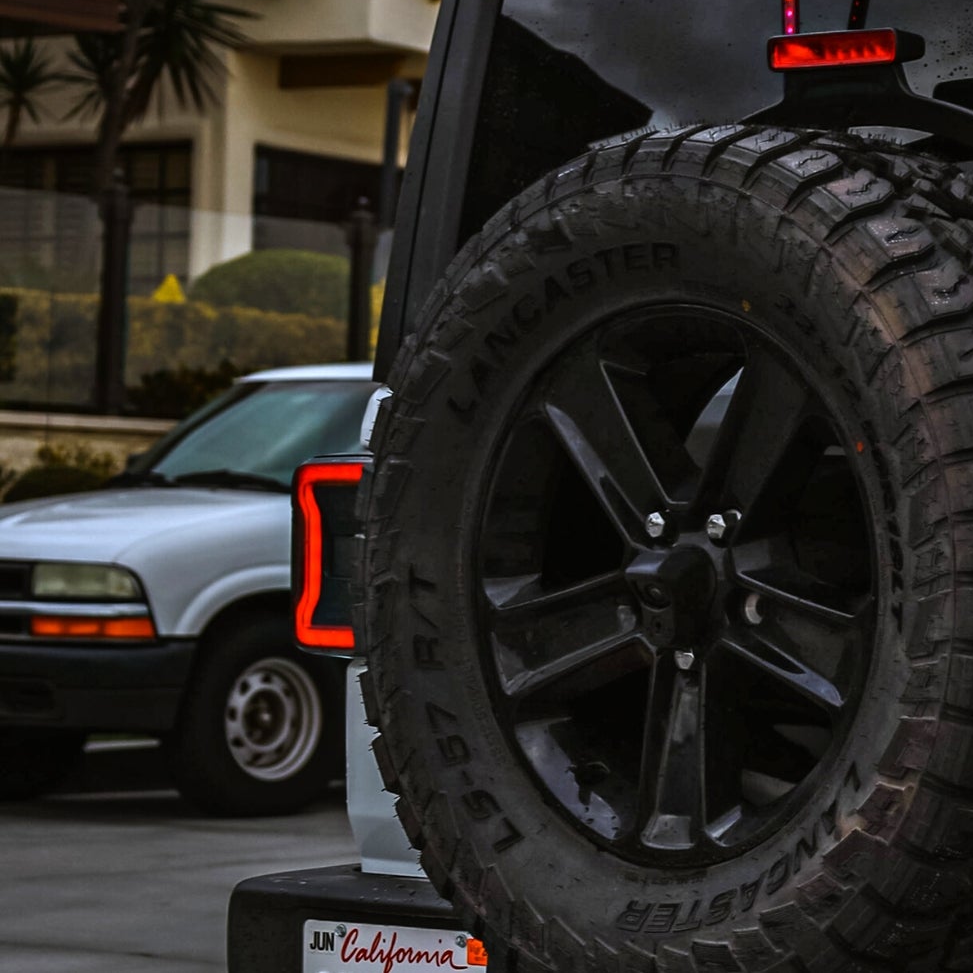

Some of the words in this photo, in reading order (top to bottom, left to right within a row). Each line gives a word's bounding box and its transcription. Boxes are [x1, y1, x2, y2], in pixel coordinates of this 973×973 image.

[446, 241, 682, 418] LANCASTER
[408, 562, 447, 671] R/T
[615, 760, 863, 934] LANCASTER
[310, 930, 335, 952] JUN
[341, 927, 468, 973] California
